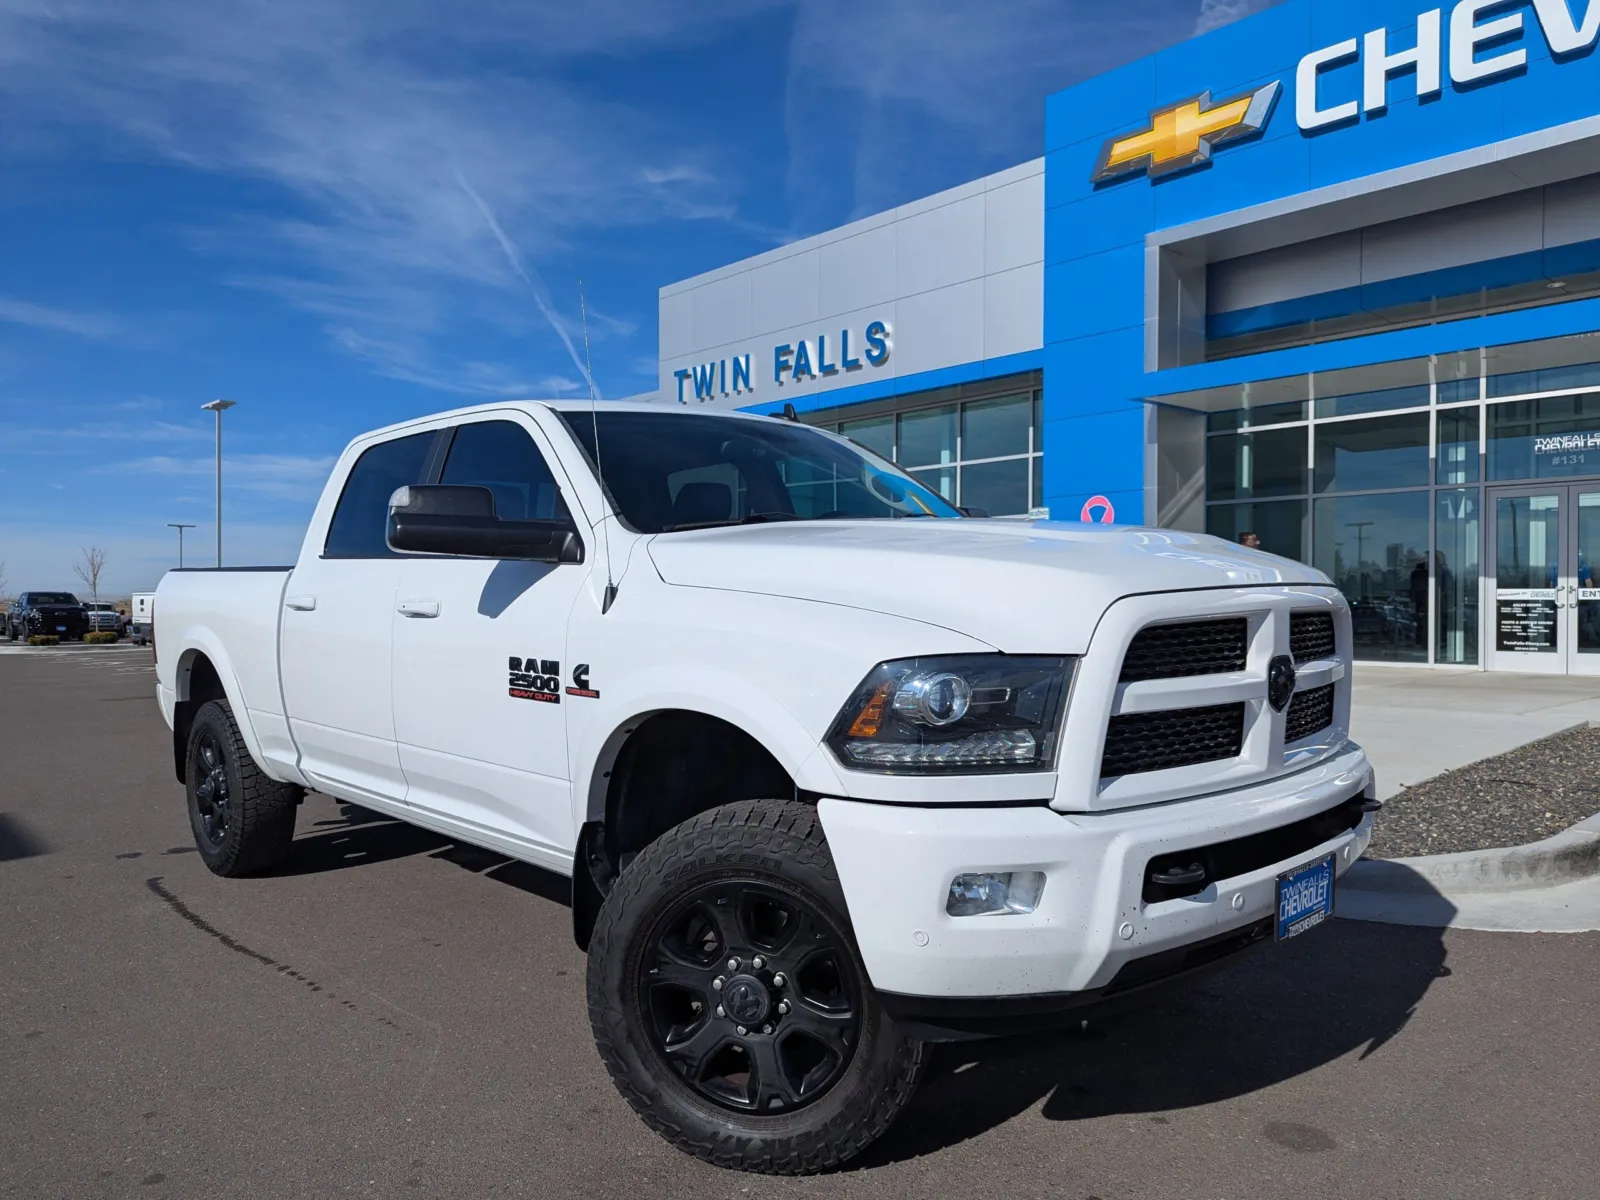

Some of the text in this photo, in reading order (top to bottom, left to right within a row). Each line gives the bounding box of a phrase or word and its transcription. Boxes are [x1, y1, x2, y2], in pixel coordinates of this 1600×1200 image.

[1295, 0, 1600, 130] CHEV
[674, 321, 890, 403] TWIN FALLS
[1552, 454, 1585, 466] #131
[509, 656, 560, 677] RAM
[509, 672, 560, 693] 2500
[510, 690, 533, 698] HEAVY
[535, 692, 557, 701] DUTY
[660, 853, 783, 887] FALKEN
[1281, 870, 1329, 901] TWINFALLS
[1279, 880, 1329, 921] CHEVROLET
